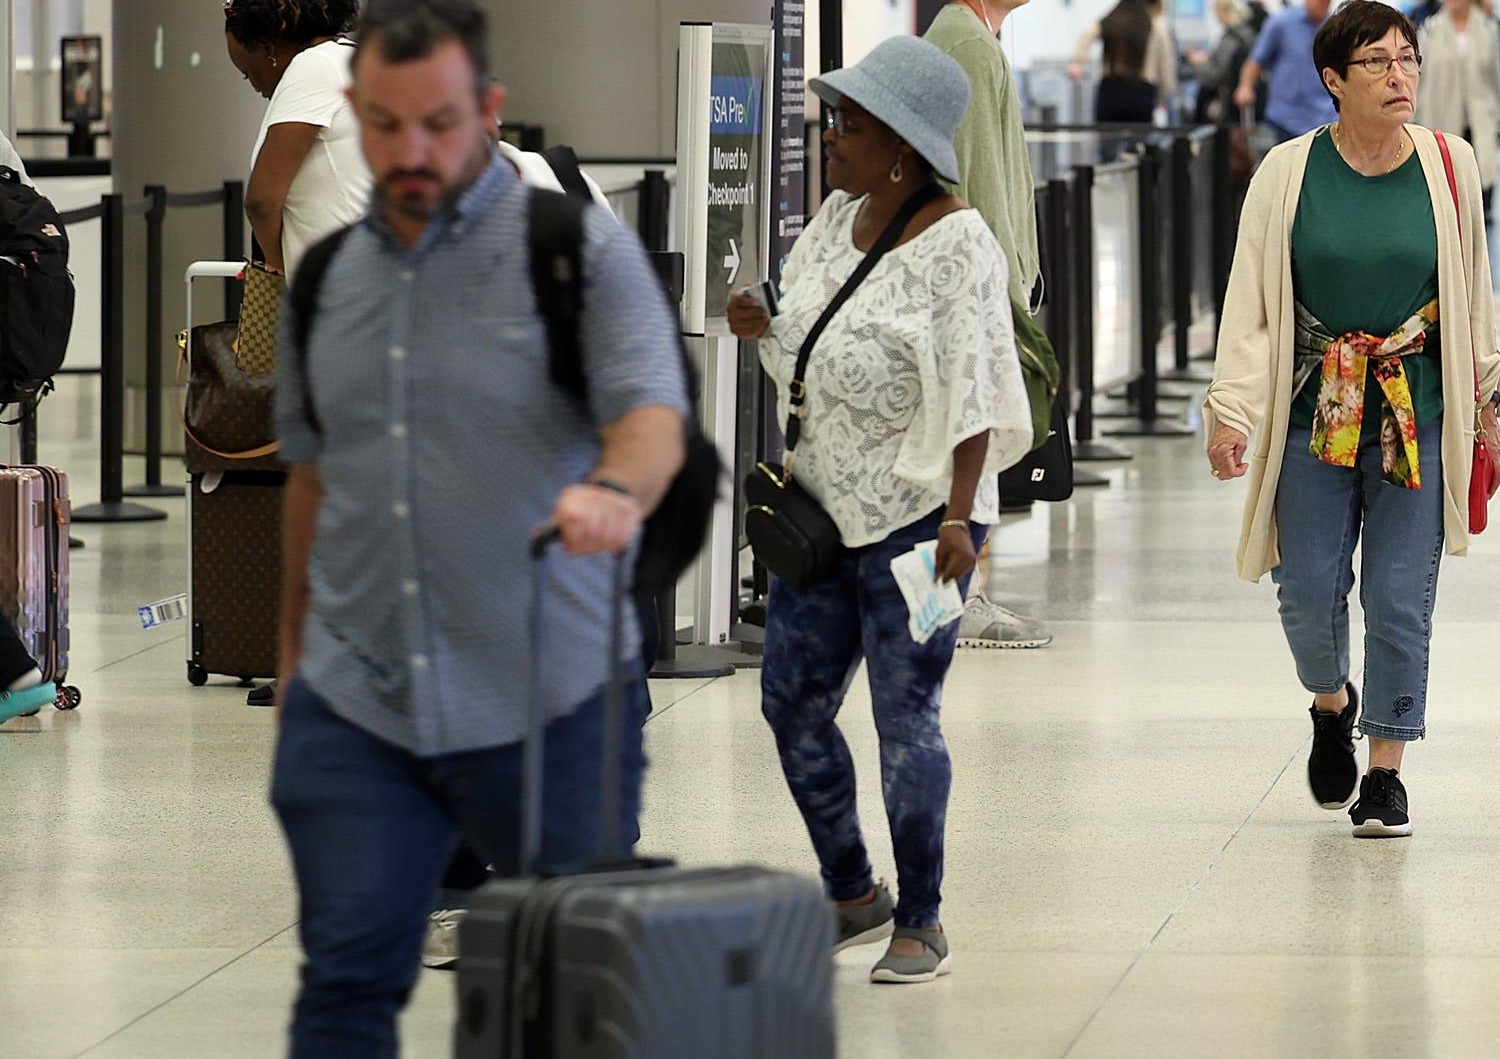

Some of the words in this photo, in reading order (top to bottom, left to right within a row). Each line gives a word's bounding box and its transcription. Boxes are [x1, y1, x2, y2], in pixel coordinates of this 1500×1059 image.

[709, 96, 728, 124] TSA
[729, 96, 744, 123] Pre
[713, 147, 739, 171] Moved
[740, 148, 749, 170] to
[708, 182, 748, 211] Checkpoint
[749, 182, 755, 204] 1
